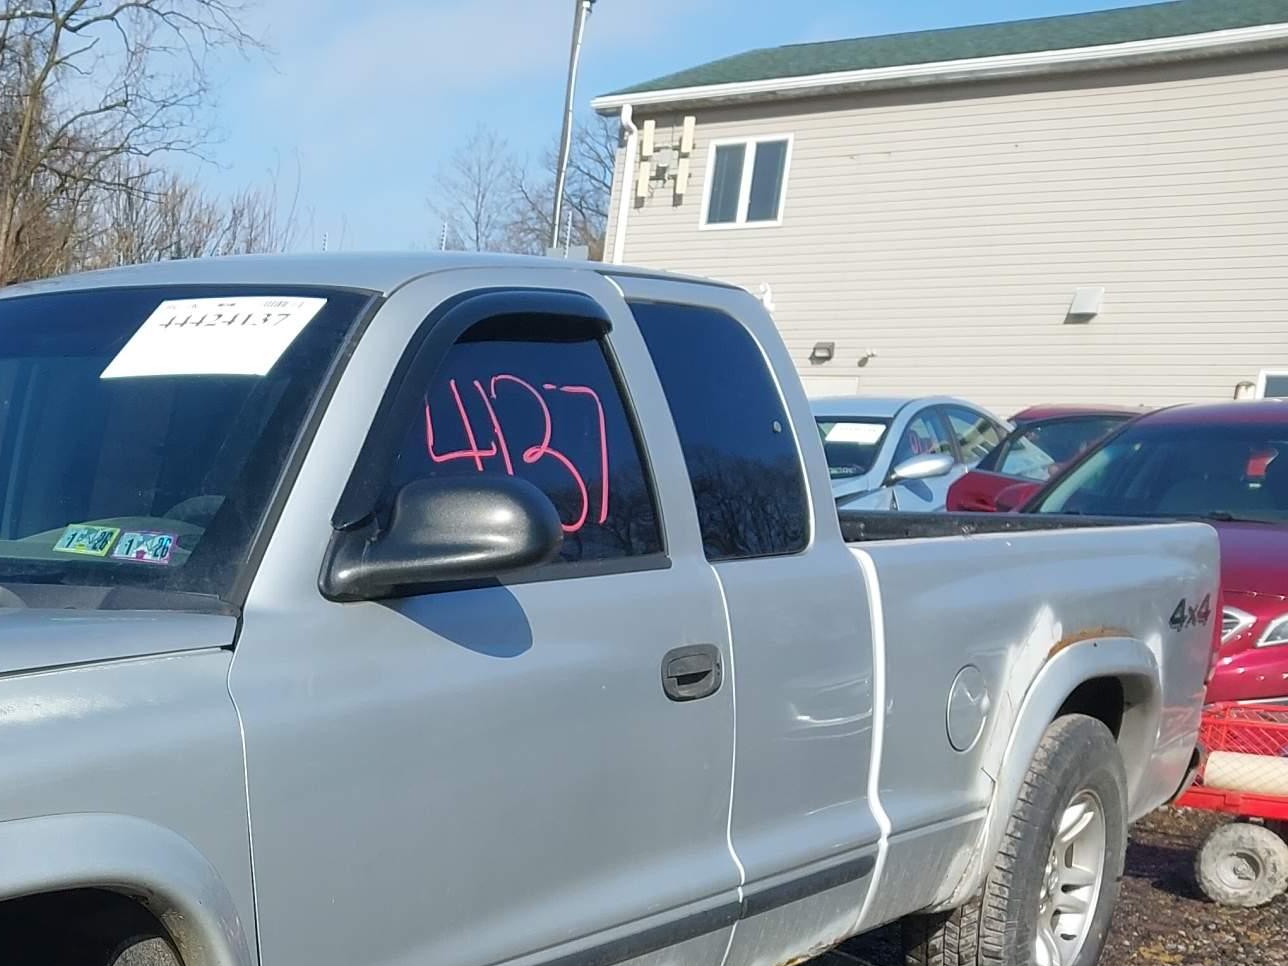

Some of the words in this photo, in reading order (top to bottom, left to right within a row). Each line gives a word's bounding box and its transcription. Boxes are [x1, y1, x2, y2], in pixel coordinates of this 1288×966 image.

[424, 373, 610, 533] 4137
[153, 536, 172, 559] 26
[1168, 592, 1211, 632] 4x4
